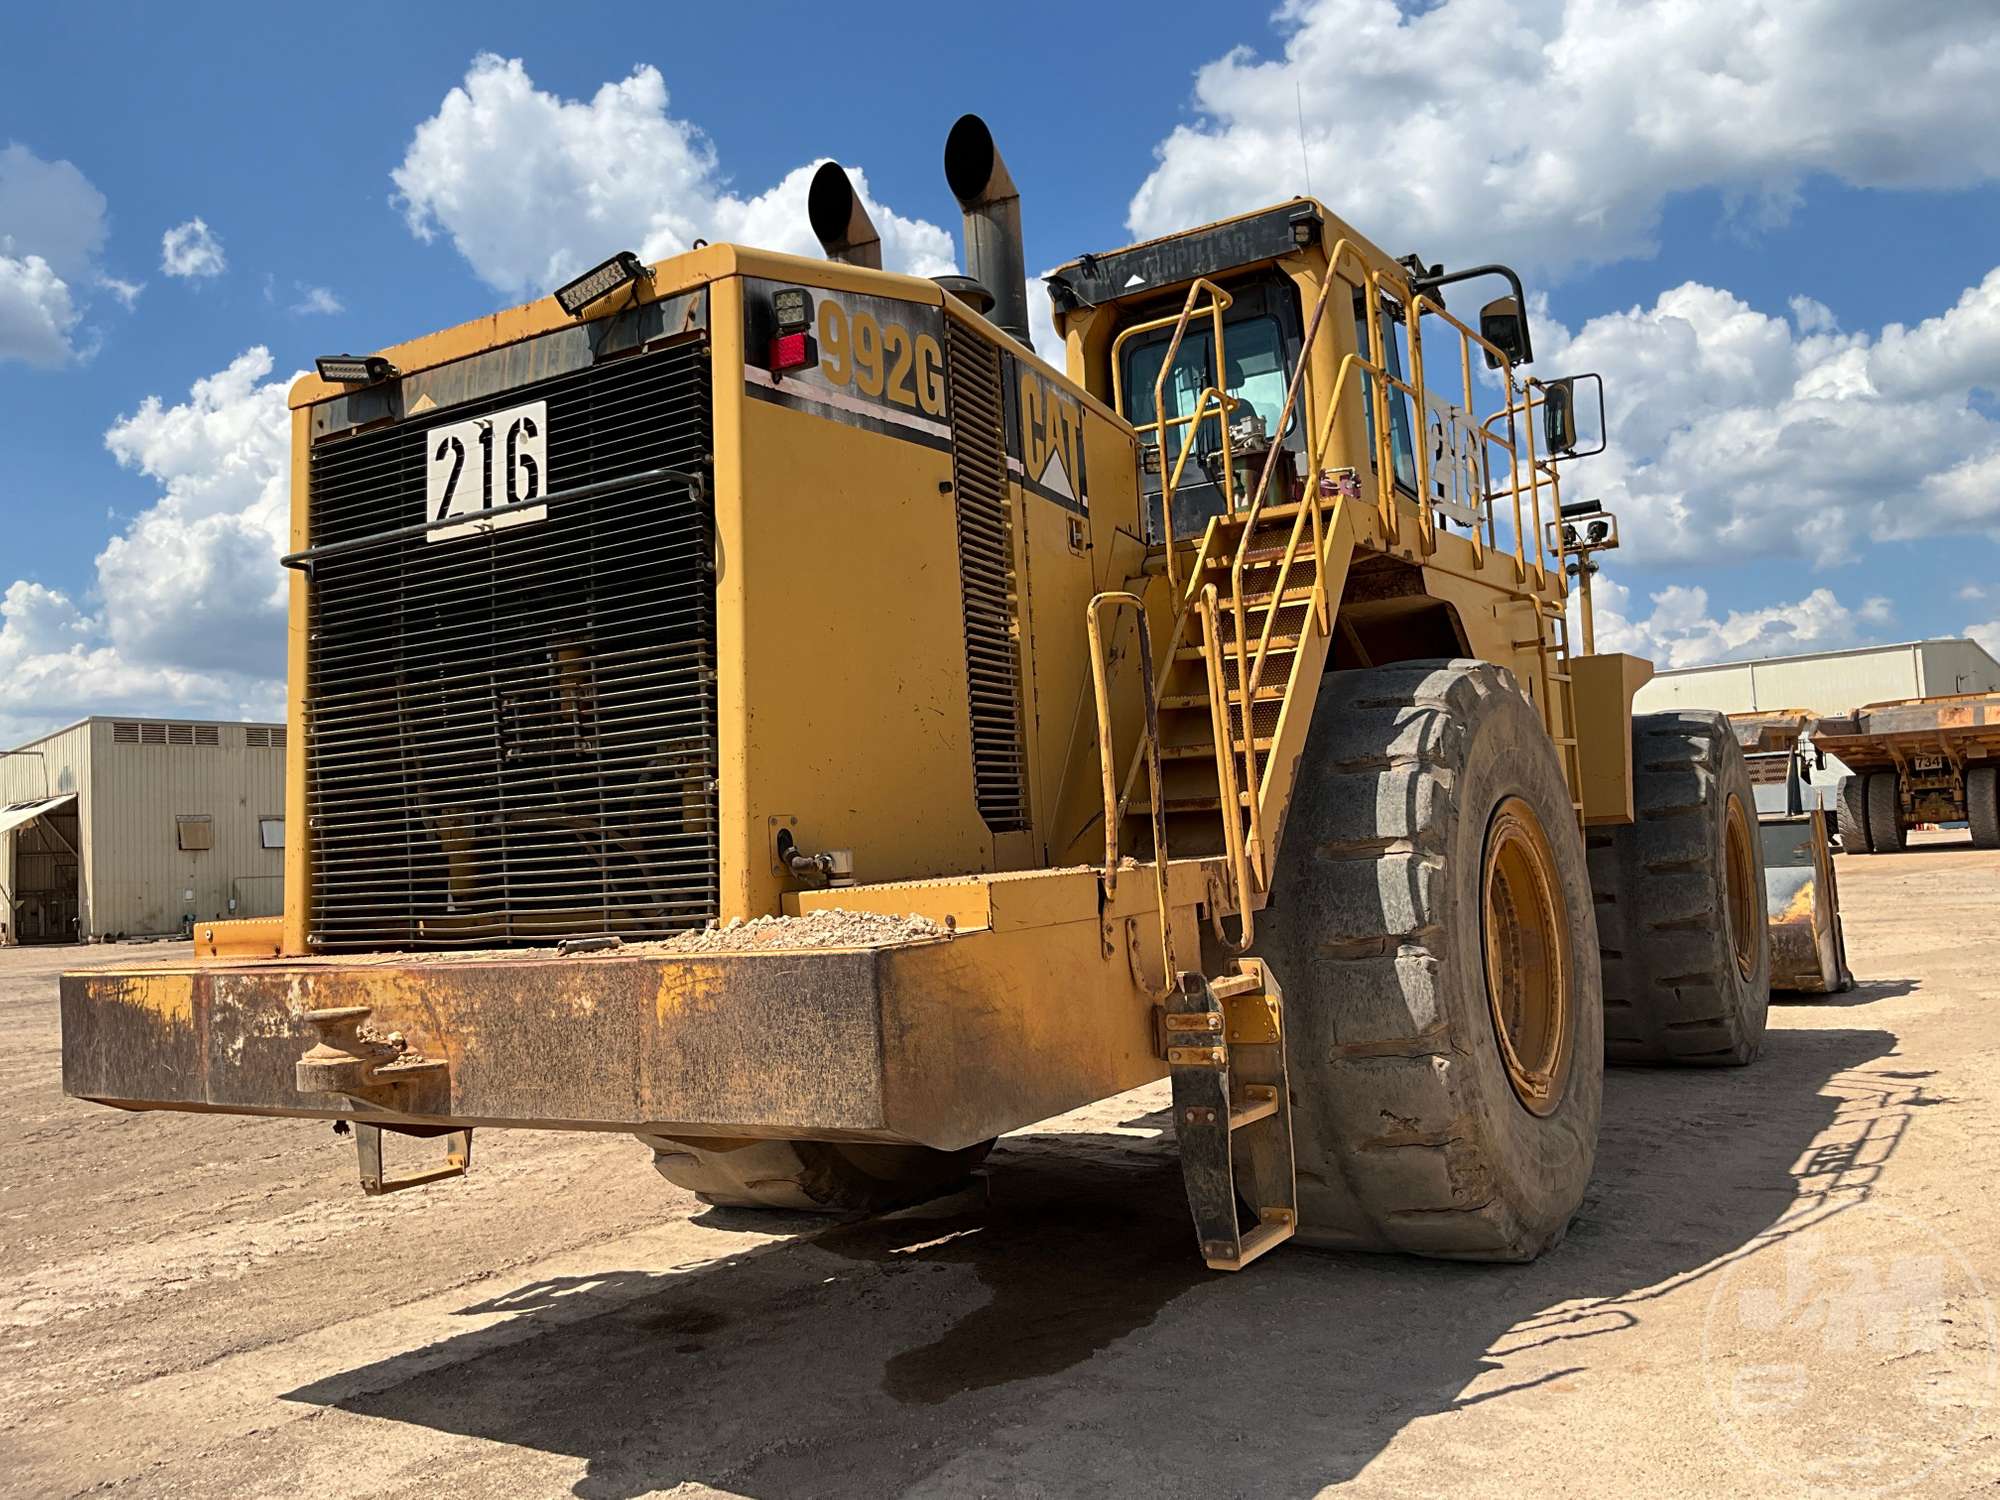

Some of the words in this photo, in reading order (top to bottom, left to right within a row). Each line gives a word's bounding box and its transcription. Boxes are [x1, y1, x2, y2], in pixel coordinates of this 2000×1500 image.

[818, 299, 947, 417] 992G
[435, 416, 538, 530] 216
[1021, 373, 1081, 507] CAT
[1915, 756, 1940, 768] 734
